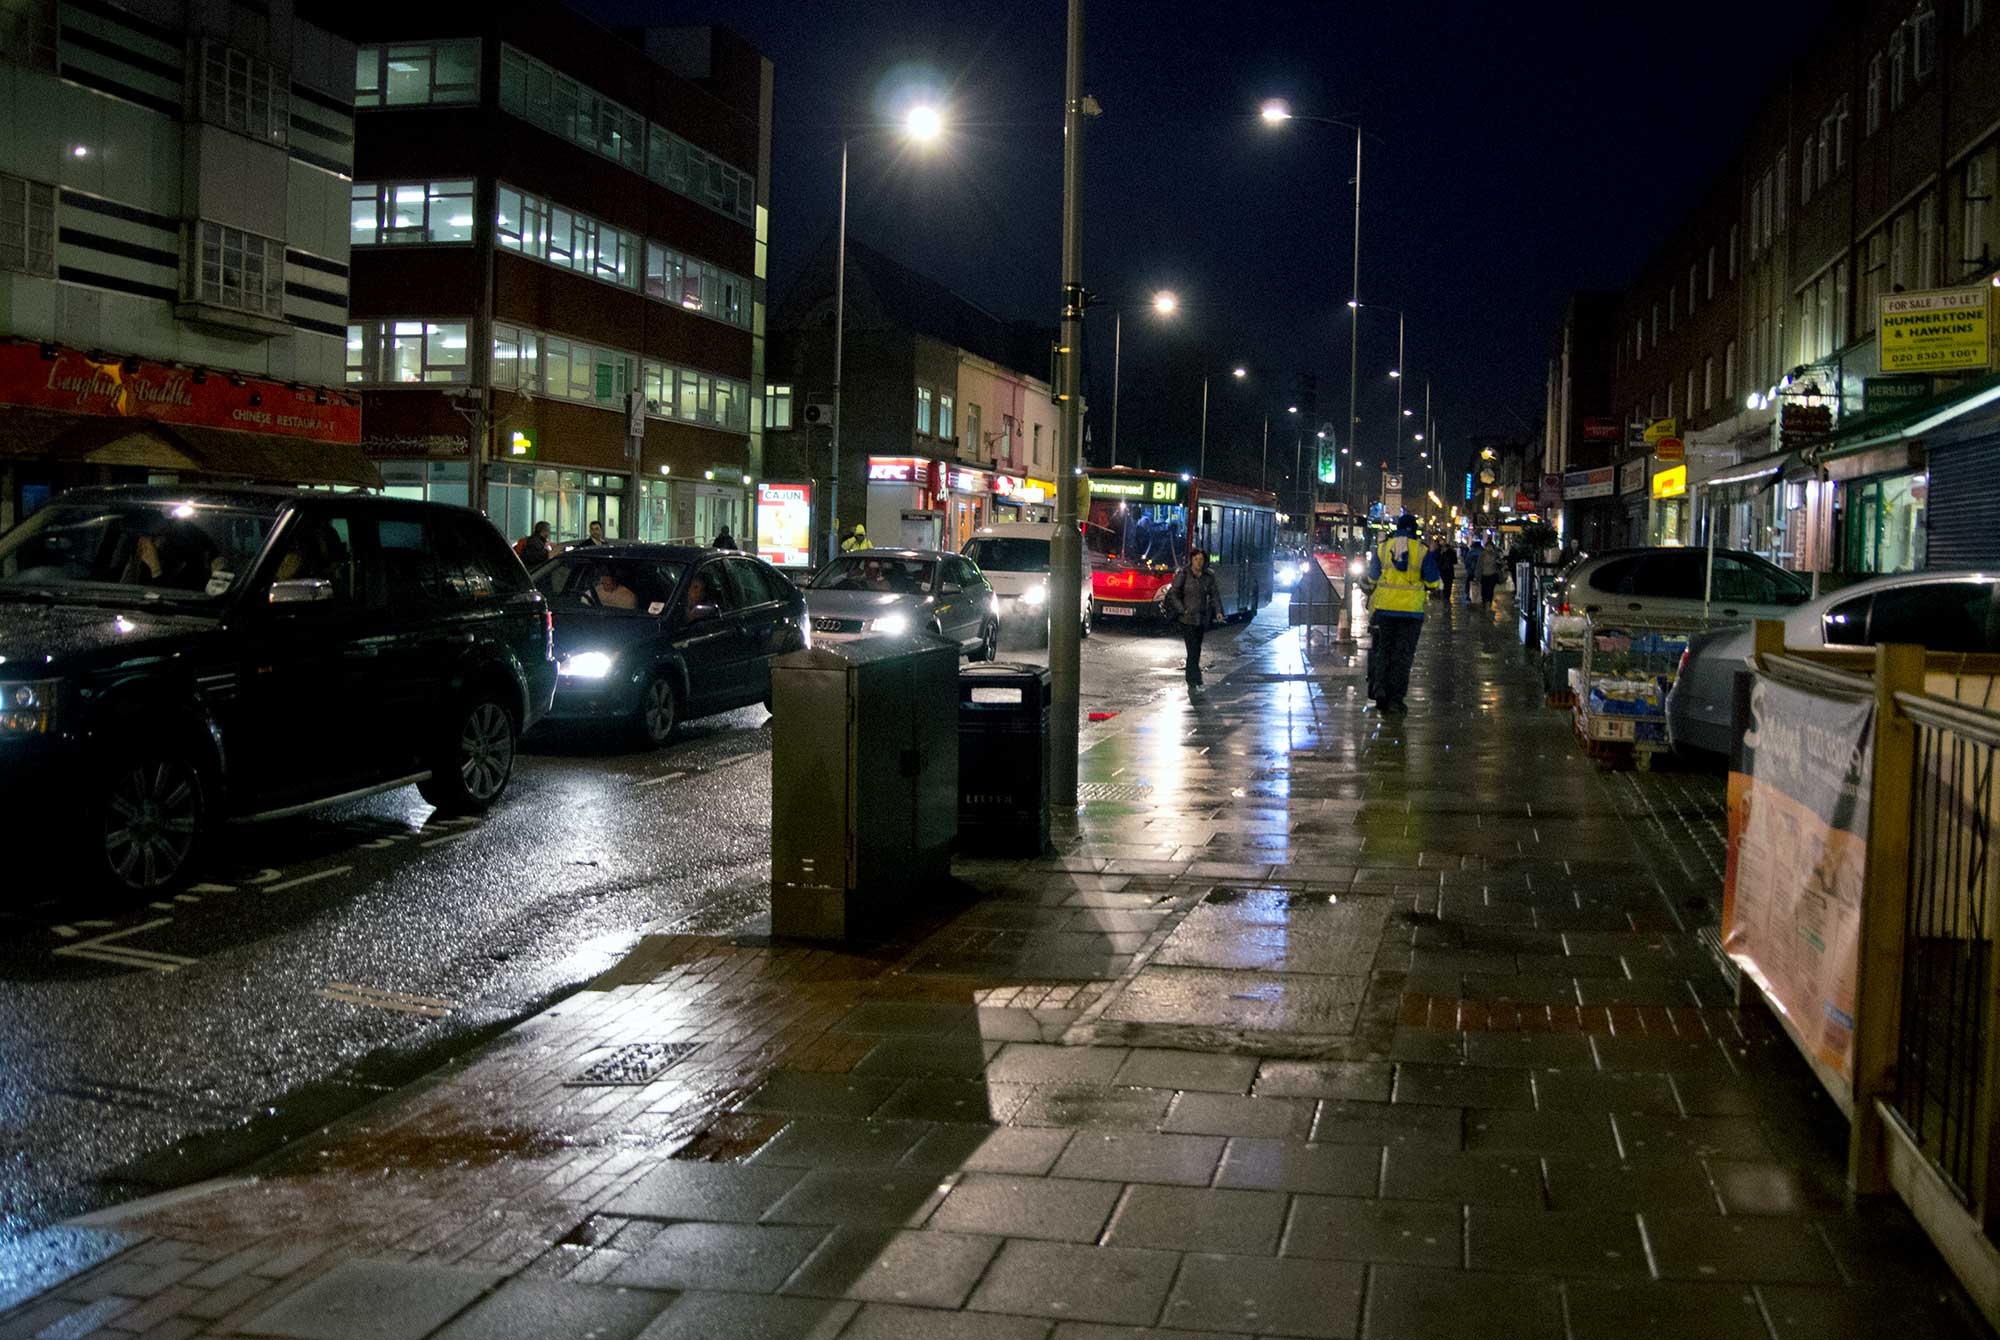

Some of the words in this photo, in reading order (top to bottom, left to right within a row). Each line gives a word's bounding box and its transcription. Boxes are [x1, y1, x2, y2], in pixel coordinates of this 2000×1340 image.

[1889, 300, 1907, 311] FOR
[1910, 298, 1932, 309] SALE
[1942, 295, 1957, 306] TO
[1960, 293, 1980, 304] LET
[1884, 311, 1984, 326] HUMMERSTONE
[1894, 329, 1904, 338] &
[1909, 322, 1974, 337] HAWKINS
[1892, 354, 1913, 363] 020
[47, 357, 124, 408] Laughing
[135, 374, 193, 406] Buddha
[232, 408, 272, 425] CHINESE
[277, 415, 335, 431] RESTAURAT
[869, 464, 911, 479] KFC
[764, 491, 802, 500] CAJUN
